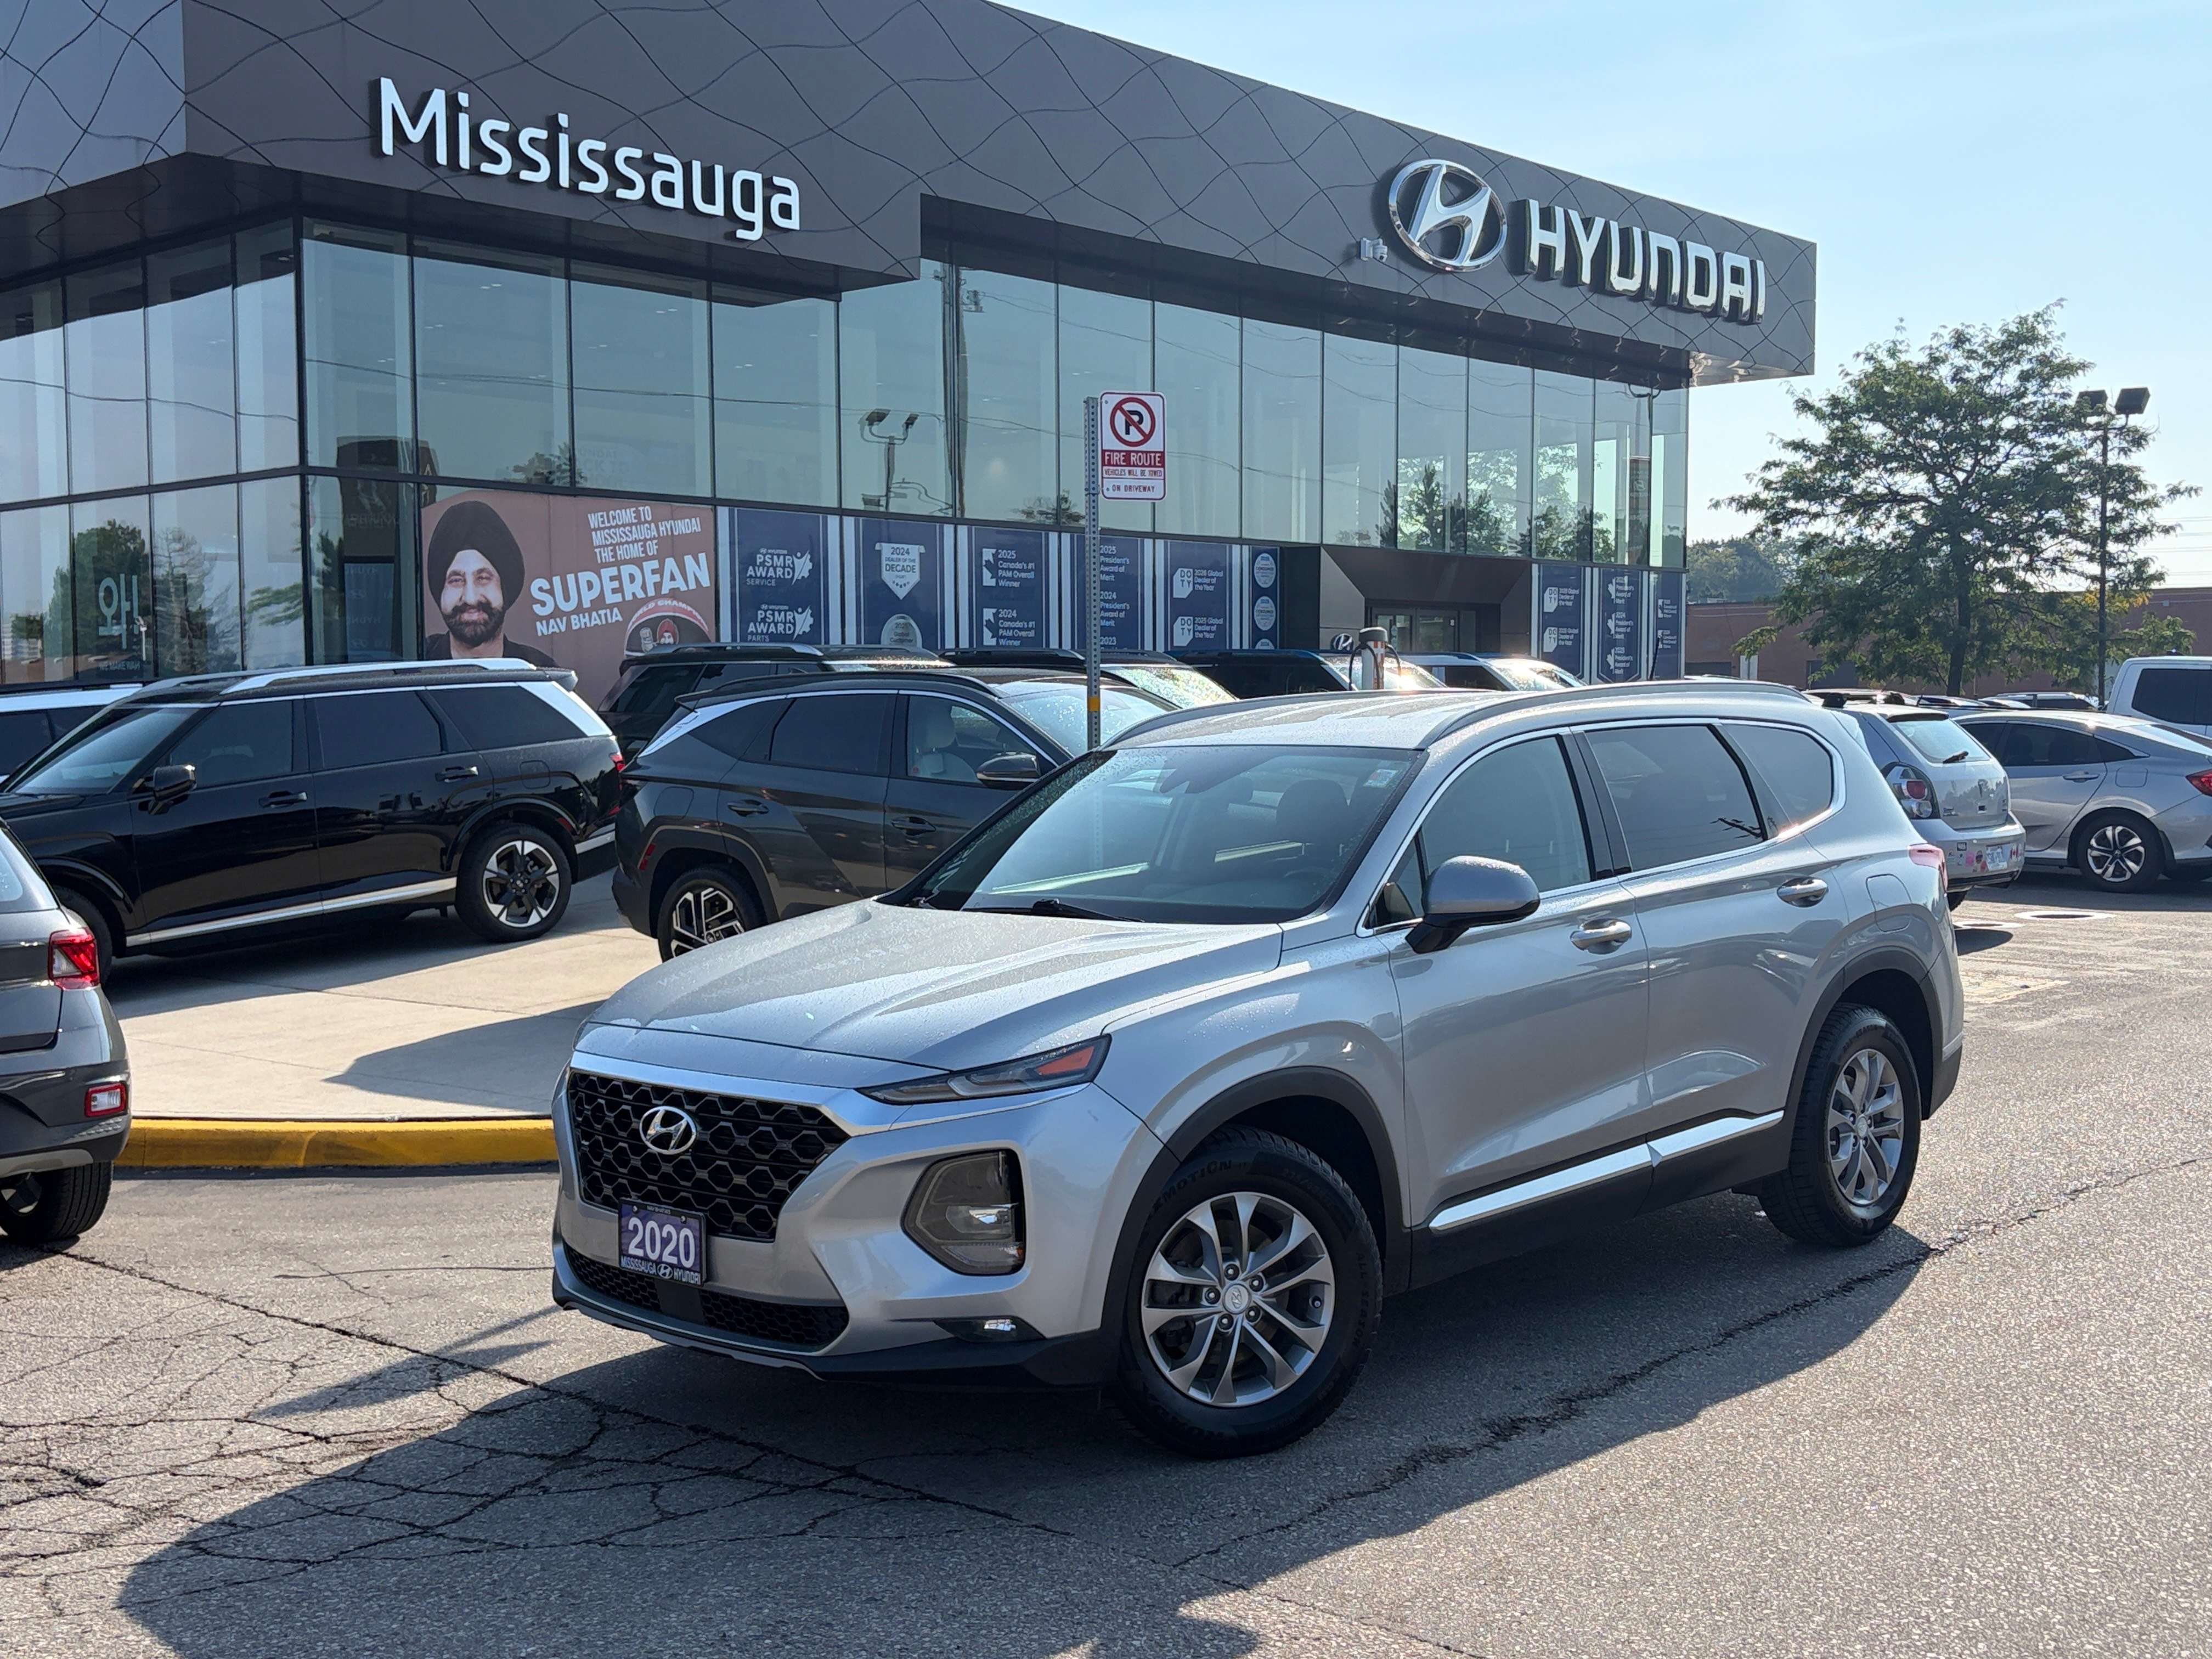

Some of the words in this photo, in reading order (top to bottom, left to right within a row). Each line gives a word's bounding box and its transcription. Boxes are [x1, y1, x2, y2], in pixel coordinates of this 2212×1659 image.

[379, 76, 800, 241] Mississauga
[1526, 198, 1765, 324] HYUNDAI
[1104, 452, 1126, 465] FIRE
[1131, 453, 1162, 466] ROUTE
[588, 507, 637, 529] WELCOME
[639, 505, 652, 521] TO
[591, 523, 657, 546] MISSISSAUGA
[658, 517, 702, 538] HYUNDAI
[594, 546, 615, 563] THE
[616, 543, 645, 561] HOME
[647, 540, 659, 556] OF
[891, 546, 910, 556] 2024
[998, 550, 1015, 559] 2025
[1100, 545, 1116, 554] 2025
[757, 554, 793, 568] PSMR
[998, 561, 1026, 569] Canada's
[1100, 556, 1130, 565] President's
[747, 566, 793, 579] AWARD
[885, 563, 916, 573] DECADE
[1013, 571, 1035, 579] Overall
[1180, 569, 1192, 578] DO
[529, 552, 710, 617] SUPERFAN
[998, 579, 1020, 588] Winner
[1180, 580, 1192, 588] TY
[1100, 591, 1116, 600] 2024
[1100, 601, 1130, 610] President's
[758, 610, 794, 623] PSMR
[998, 609, 1017, 618] 2024
[535, 618, 566, 637] NAV
[571, 607, 623, 630] BHATIA
[1181, 618, 1192, 627] DO
[748, 622, 794, 635] AWARD
[1181, 628, 1192, 636] TY
[1100, 636, 1116, 645] 2023
[628, 1217, 696, 1268] 2020
[620, 1255, 657, 1275] MISSISSAUGA
[674, 1267, 701, 1285] HYUNDAI
